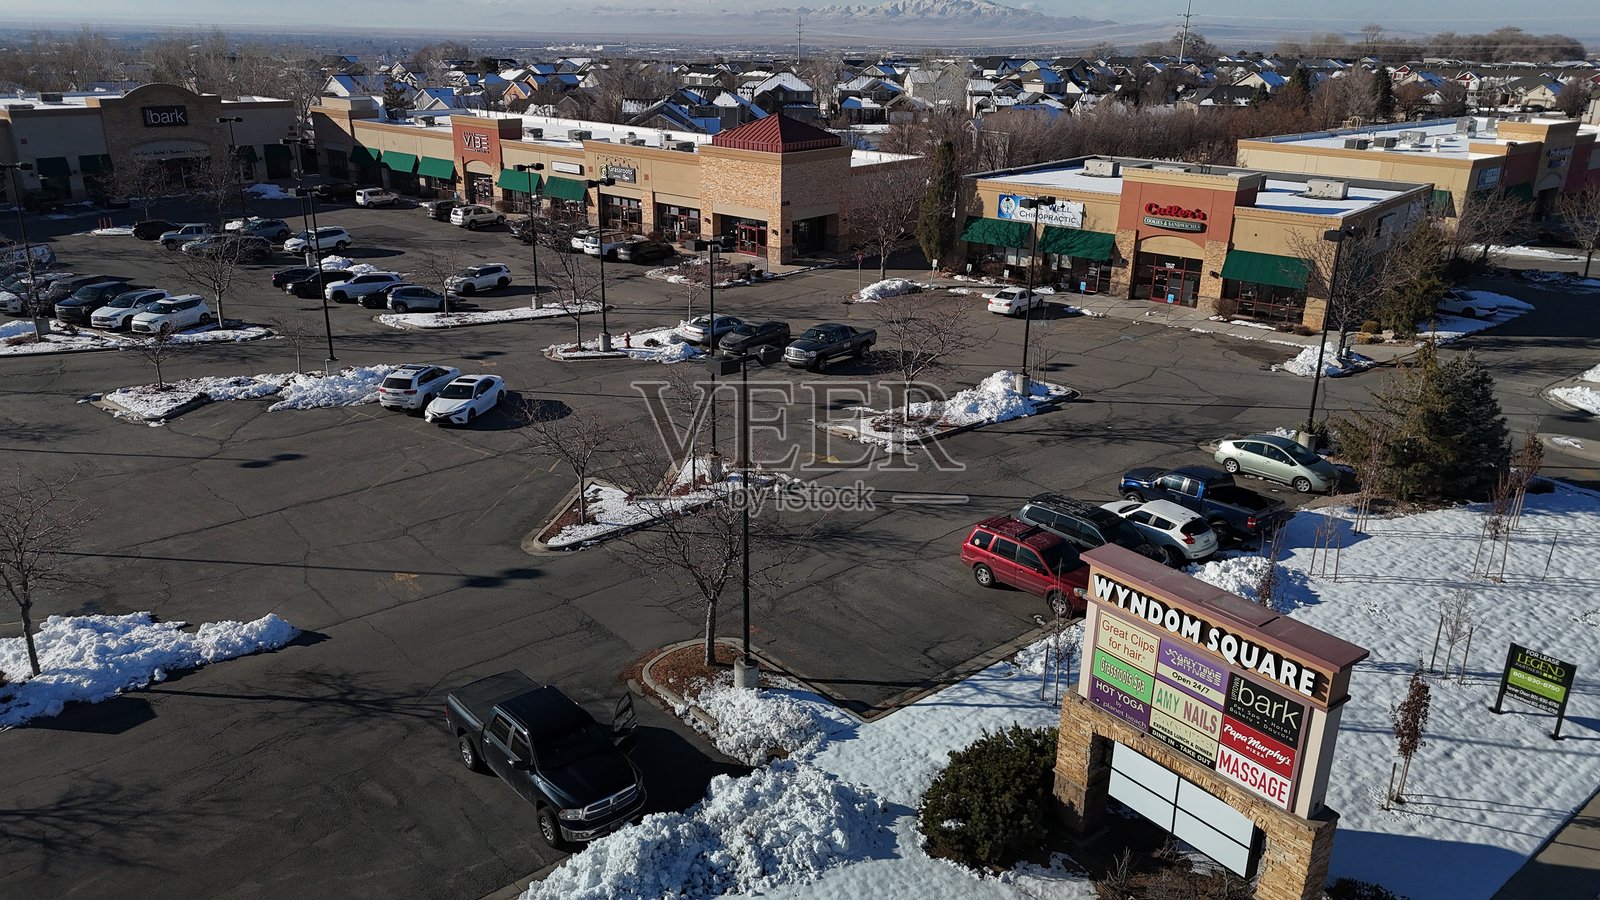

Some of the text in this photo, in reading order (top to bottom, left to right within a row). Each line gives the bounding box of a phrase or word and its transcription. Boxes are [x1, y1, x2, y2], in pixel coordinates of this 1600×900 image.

[149, 109, 186, 124] bark
[463, 135, 488, 149] VIBE
[1019, 210, 1077, 223] CHIROPRACTIC
[1049, 204, 1072, 213] WELL
[1145, 203, 1206, 220] Cutler's
[1094, 575, 1315, 697] WYNDOM SQUARE
[1102, 620, 1155, 653] Great Clips
[1109, 637, 1121, 650] for
[1177, 654, 1222, 679] ANYTIME
[1517, 653, 1565, 677] LEGEND
[1526, 650, 1560, 666] FOR LEASE
[1100, 657, 1145, 694] Grassroots Spa
[1172, 672, 1210, 694] Open 24/7
[1177, 662, 1221, 687] FITNESS
[1096, 680, 1144, 713] HOT YOGA
[1231, 677, 1240, 701] UPTOWN
[1103, 702, 1124, 716] planet
[1126, 713, 1147, 728] beach
[1156, 688, 1180, 713] AMY
[1184, 701, 1218, 735] NAILS
[1238, 679, 1300, 730] bark
[1230, 707, 1293, 742] Bakery Daycare
[1271, 722, 1291, 735] Hotel
[1152, 729, 1167, 741] DINE
[1168, 738, 1175, 746] IN
[1180, 744, 1197, 758] TAKE
[1197, 755, 1211, 766] OUT
[1153, 721, 1173, 736] EXPRESS
[1174, 733, 1190, 745] LUNCH
[1195, 744, 1213, 758] DINNER
[1246, 746, 1265, 759] PIZZA
[1218, 749, 1289, 803] MASSAGE
